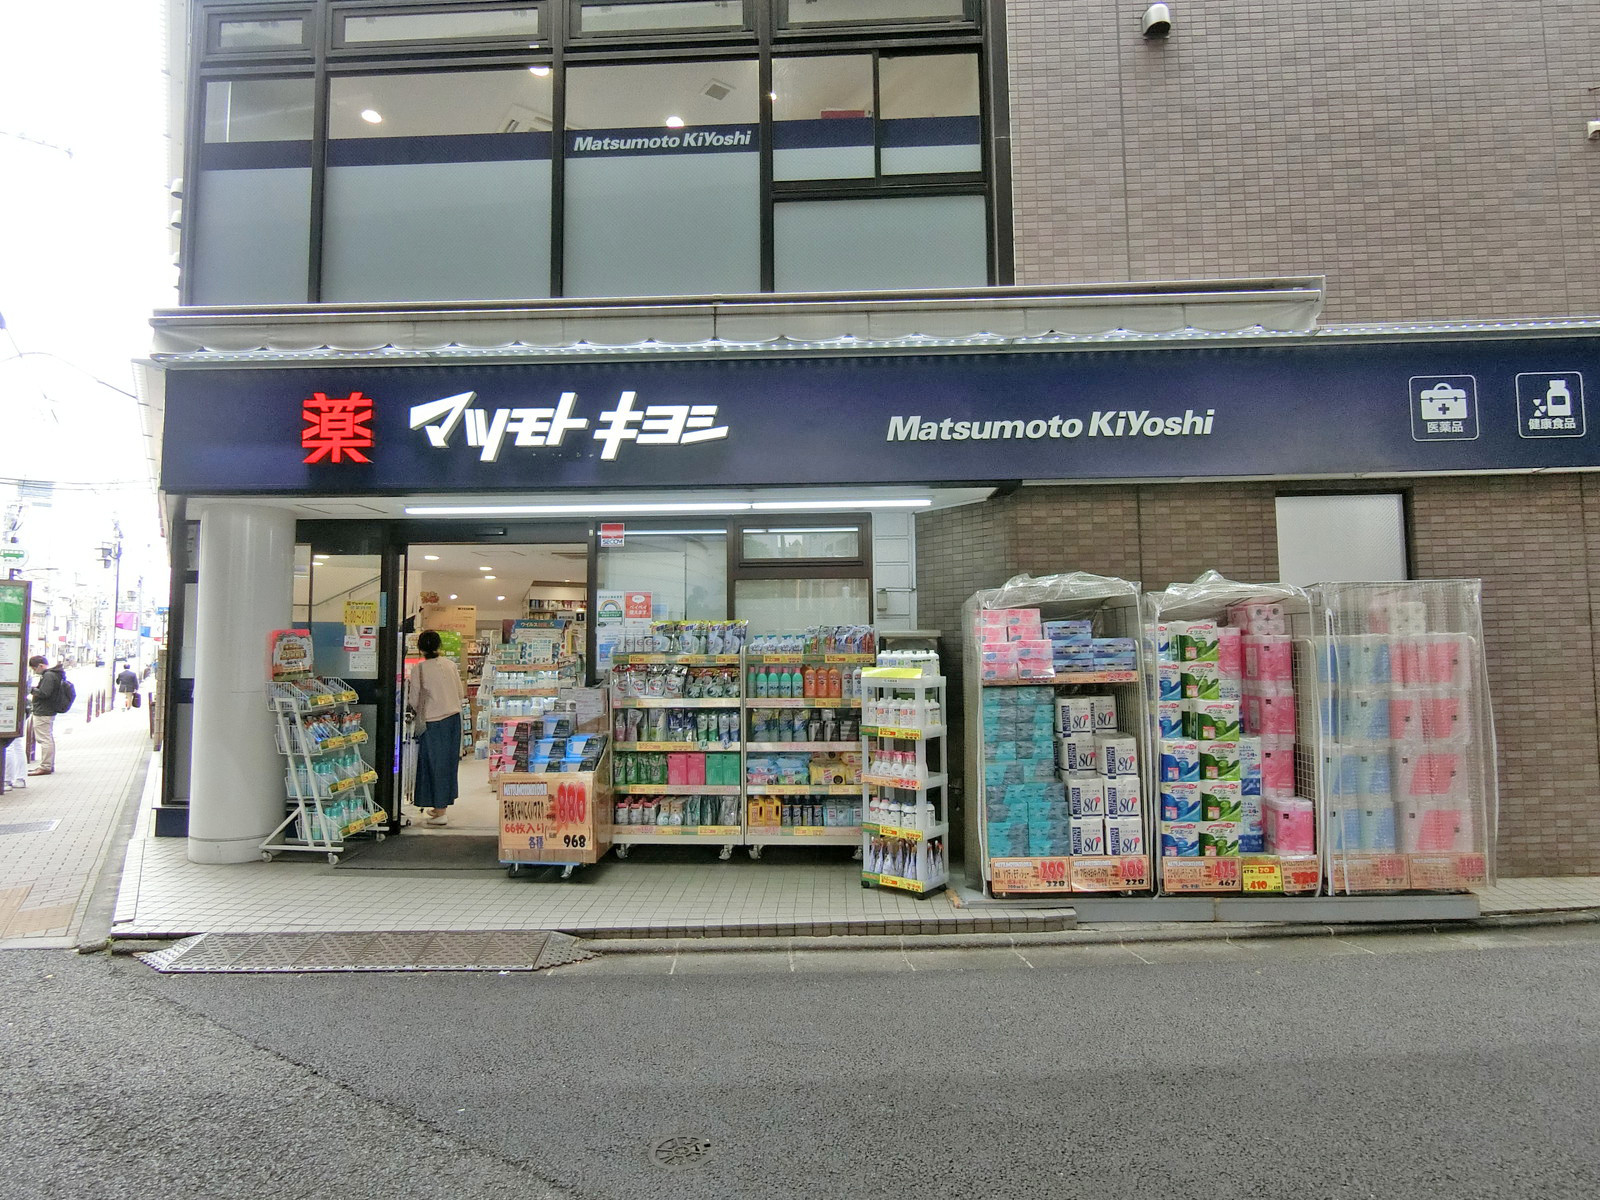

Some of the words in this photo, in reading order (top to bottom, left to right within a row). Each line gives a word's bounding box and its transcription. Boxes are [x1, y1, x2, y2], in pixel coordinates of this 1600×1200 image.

[573, 133, 681, 152] Matsumoto
[682, 130, 752, 148] KiYoshi
[301, 391, 374, 464] 薬
[886, 414, 1084, 442] Matsumoto
[1087, 408, 1216, 437] KiYoshi
[1426, 420, 1464, 434] 医薬品
[1527, 417, 1577, 431] 健康食品
[1072, 715, 1086, 729] 80
[1096, 712, 1111, 726] 80
[1078, 752, 1093, 767] 80
[557, 782, 586, 823] 880
[1083, 798, 1098, 812] 80
[1119, 798, 1134, 813] 80
[504, 823, 545, 834] 66枚入り
[563, 834, 586, 848] 968
[1083, 837, 1098, 852] 80
[1122, 838, 1137, 853] 80
[1218, 879, 1236, 887] 467
